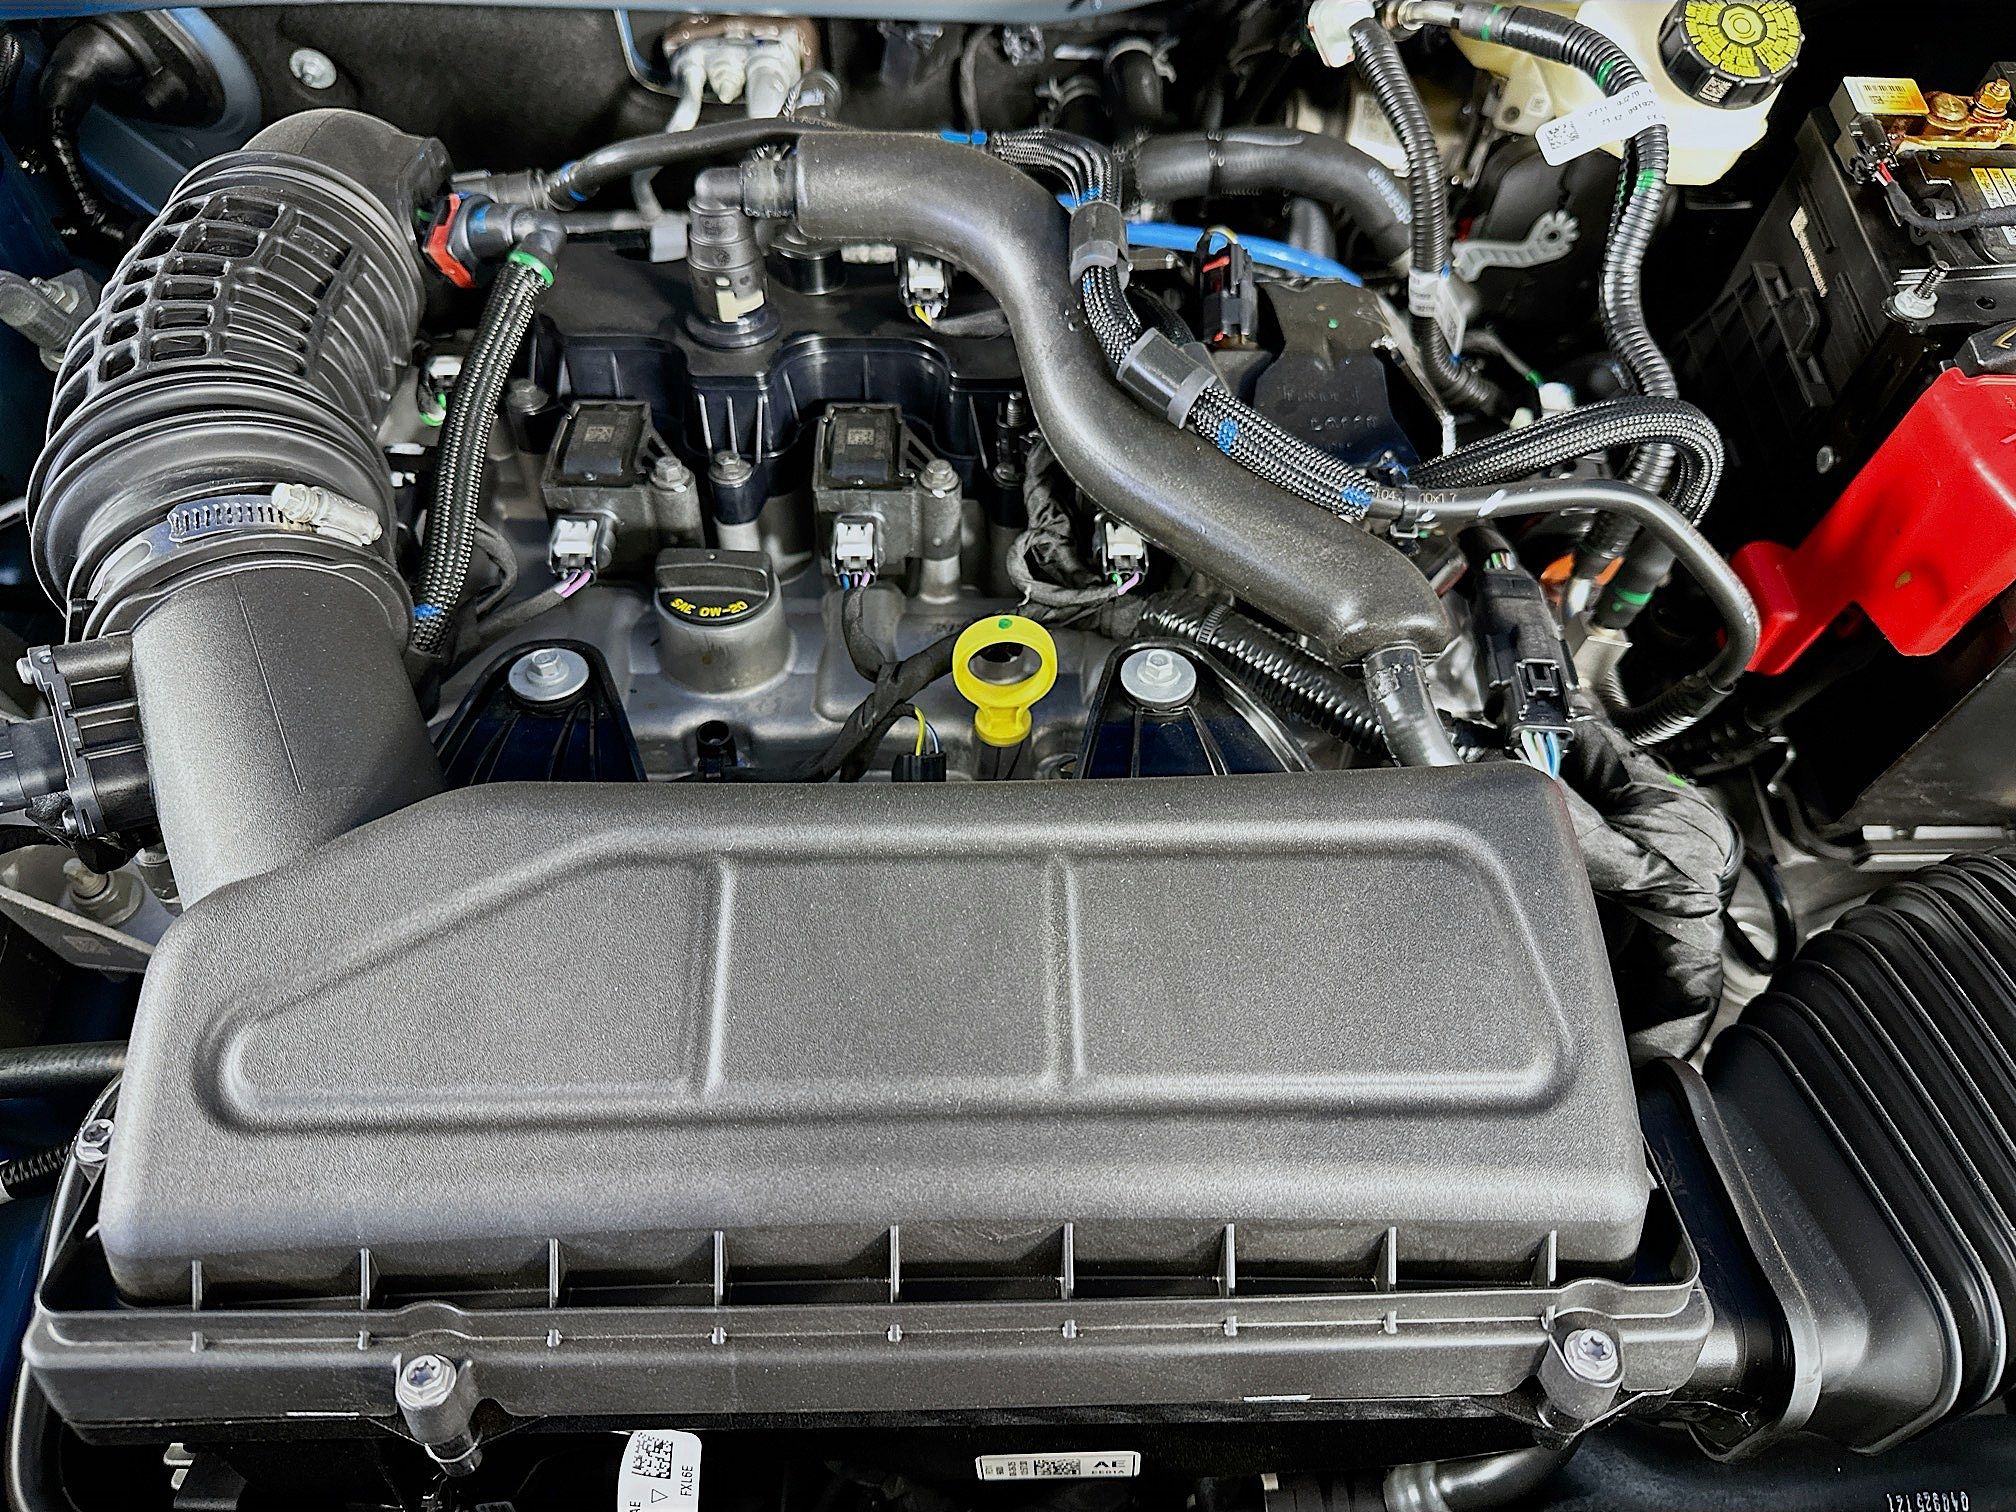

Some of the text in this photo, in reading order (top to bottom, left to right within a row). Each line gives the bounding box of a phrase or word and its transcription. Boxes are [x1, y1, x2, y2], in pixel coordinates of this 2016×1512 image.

[670, 598, 748, 617] SAE 0W-20
[1094, 1460, 1126, 1468] AE
[680, 1465, 694, 1497] FXL6E
